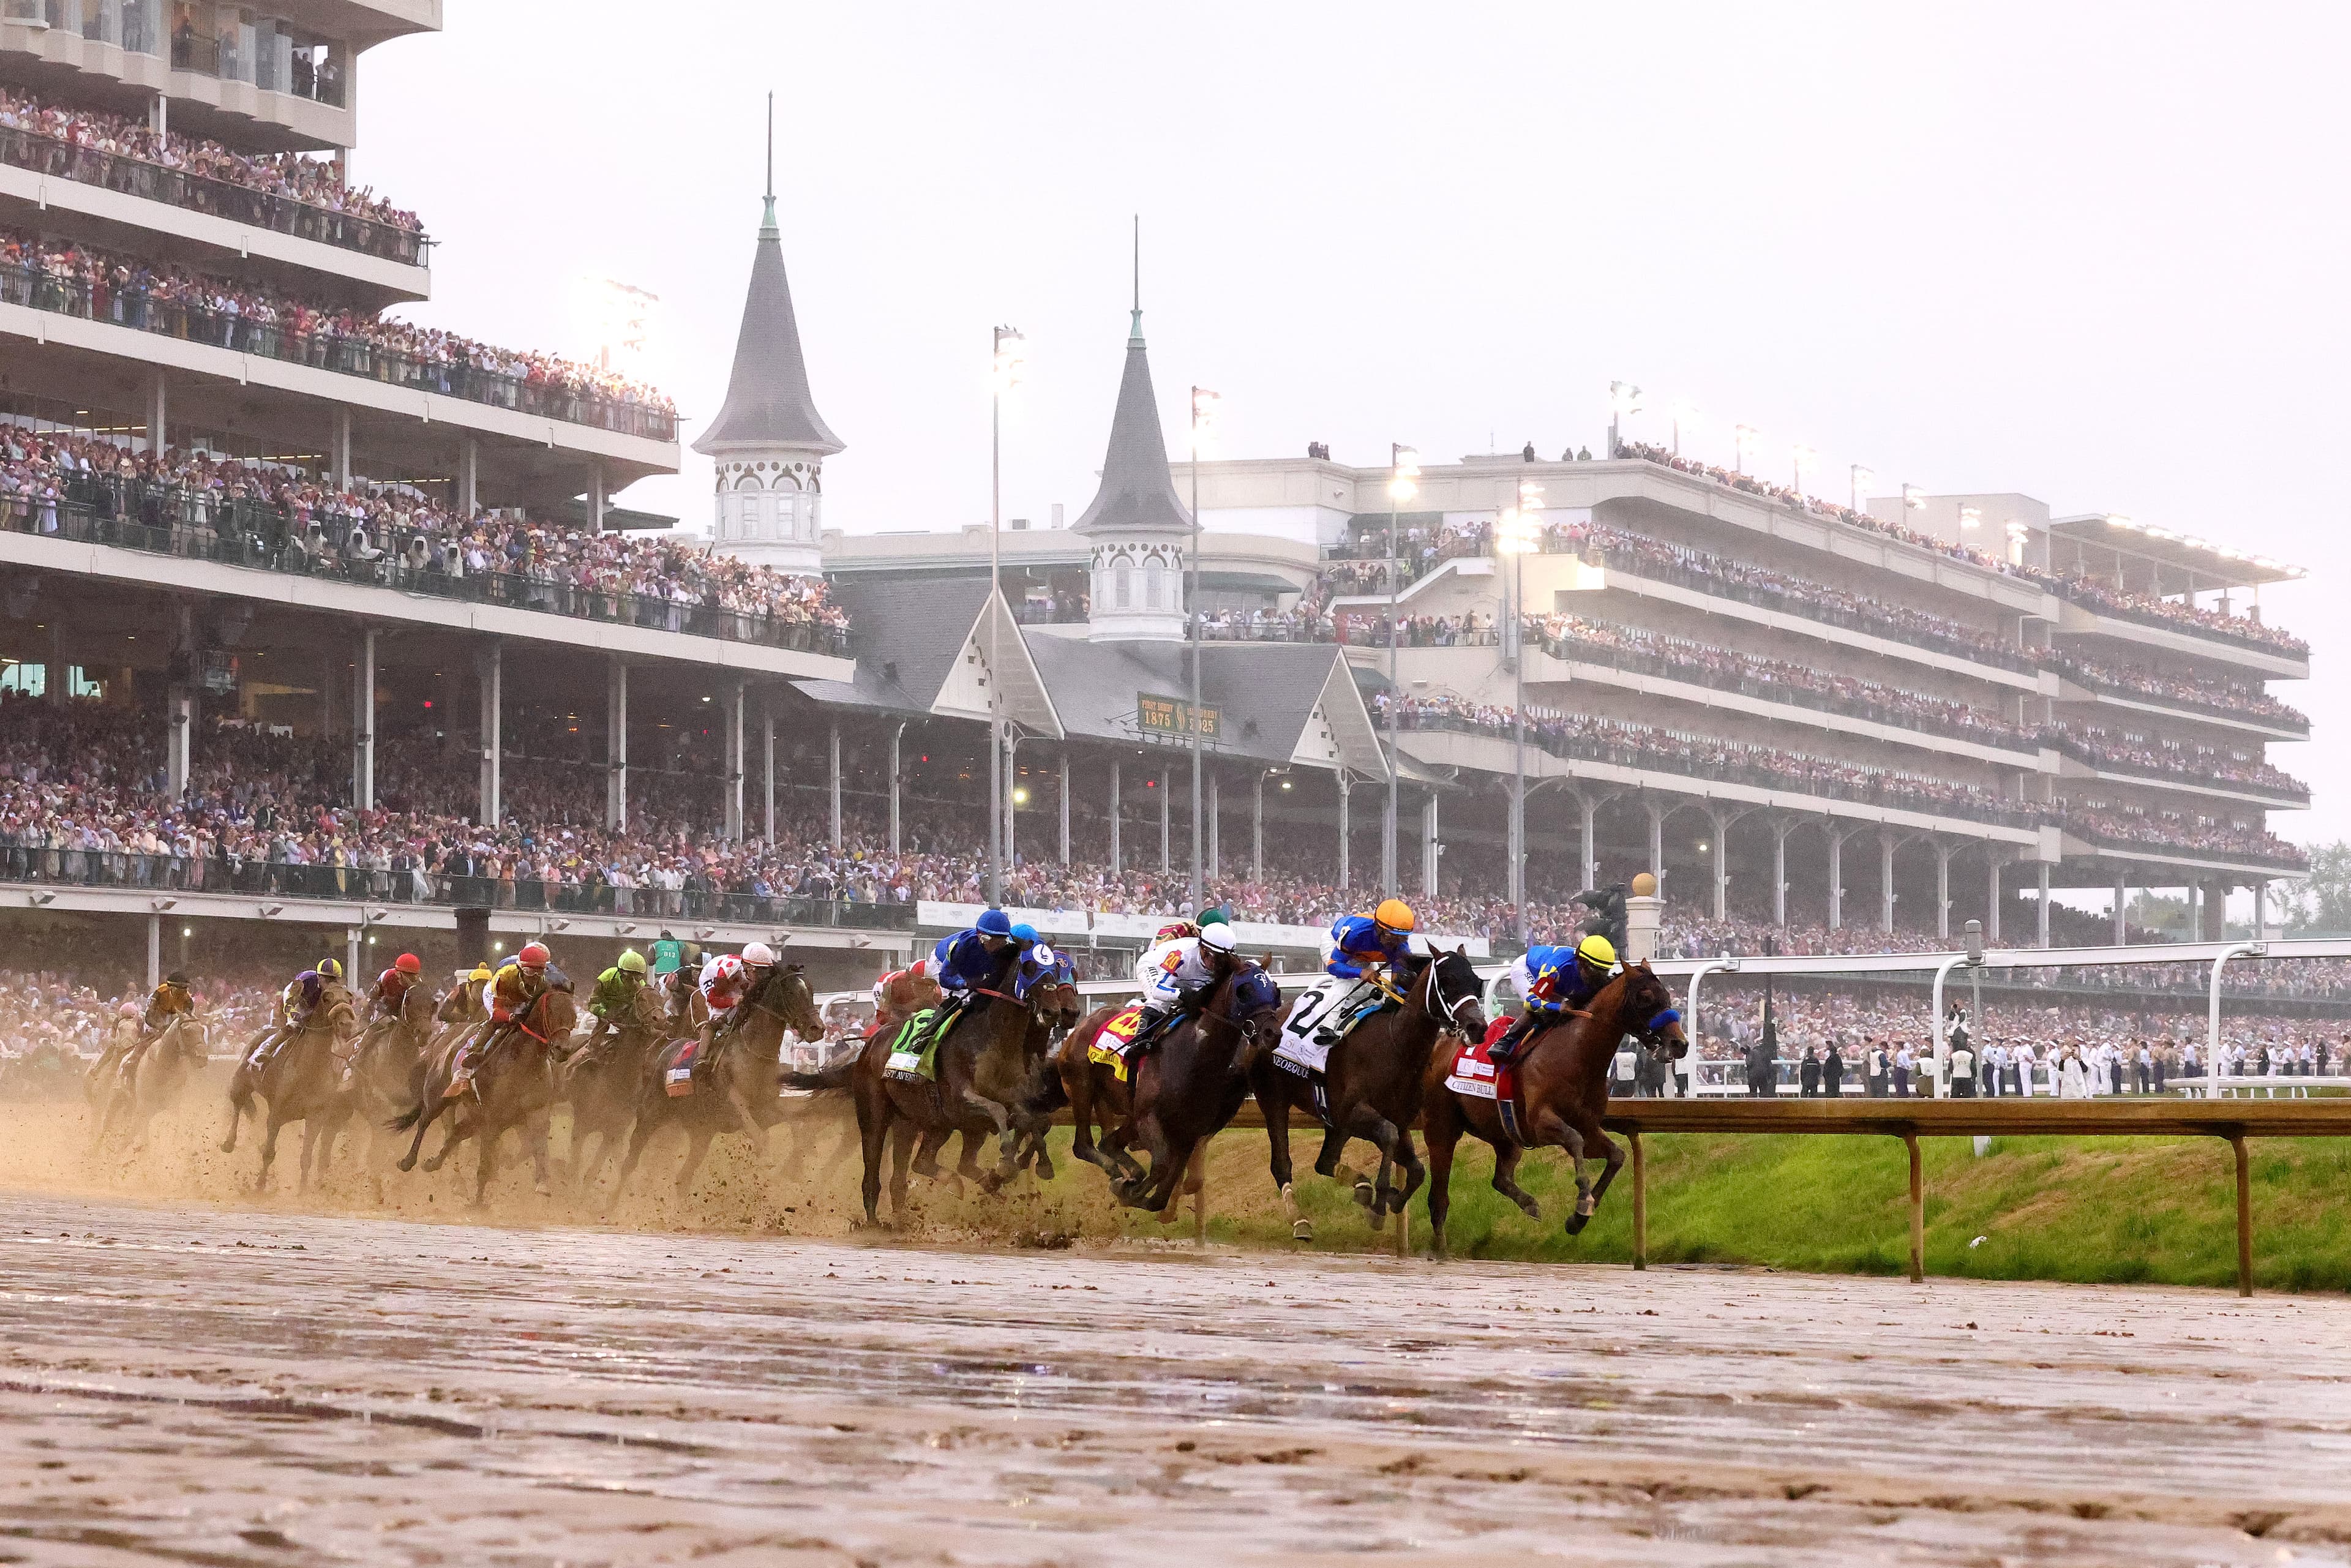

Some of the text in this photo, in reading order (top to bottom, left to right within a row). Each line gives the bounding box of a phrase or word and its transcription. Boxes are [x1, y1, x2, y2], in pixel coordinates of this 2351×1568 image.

[1145, 710, 1170, 727] 1875
[1189, 718, 1214, 733] 225
[1163, 952, 1181, 970] 20
[1286, 991, 1324, 1039] 2
[882, 1069, 896, 1078] AST
[1452, 1081, 1493, 1096] CITIZEN BULL
